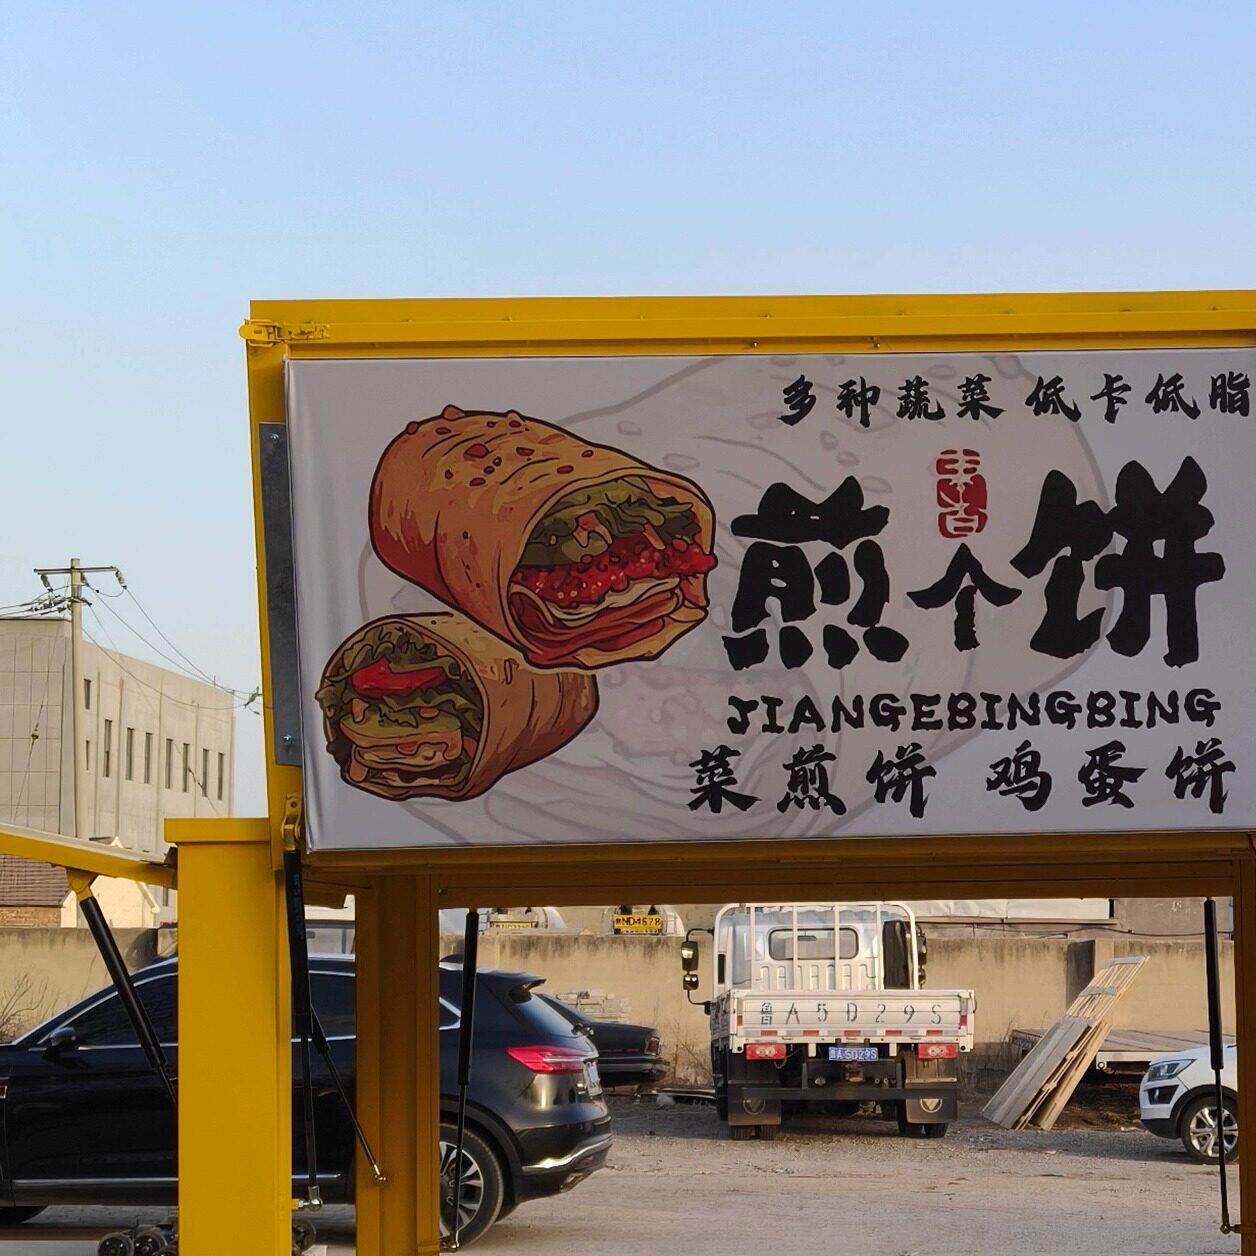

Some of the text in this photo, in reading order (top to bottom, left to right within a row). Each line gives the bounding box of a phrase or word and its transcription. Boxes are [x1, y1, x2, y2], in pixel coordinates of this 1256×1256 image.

[778, 372, 1250, 427] 多种蔬菜 低卡低脂
[721, 455, 1226, 671] 煎个饼
[727, 689, 1221, 734] JIANGEBINGBING
[687, 738, 1236, 818] 菜煎饼 鸡蛋饼
